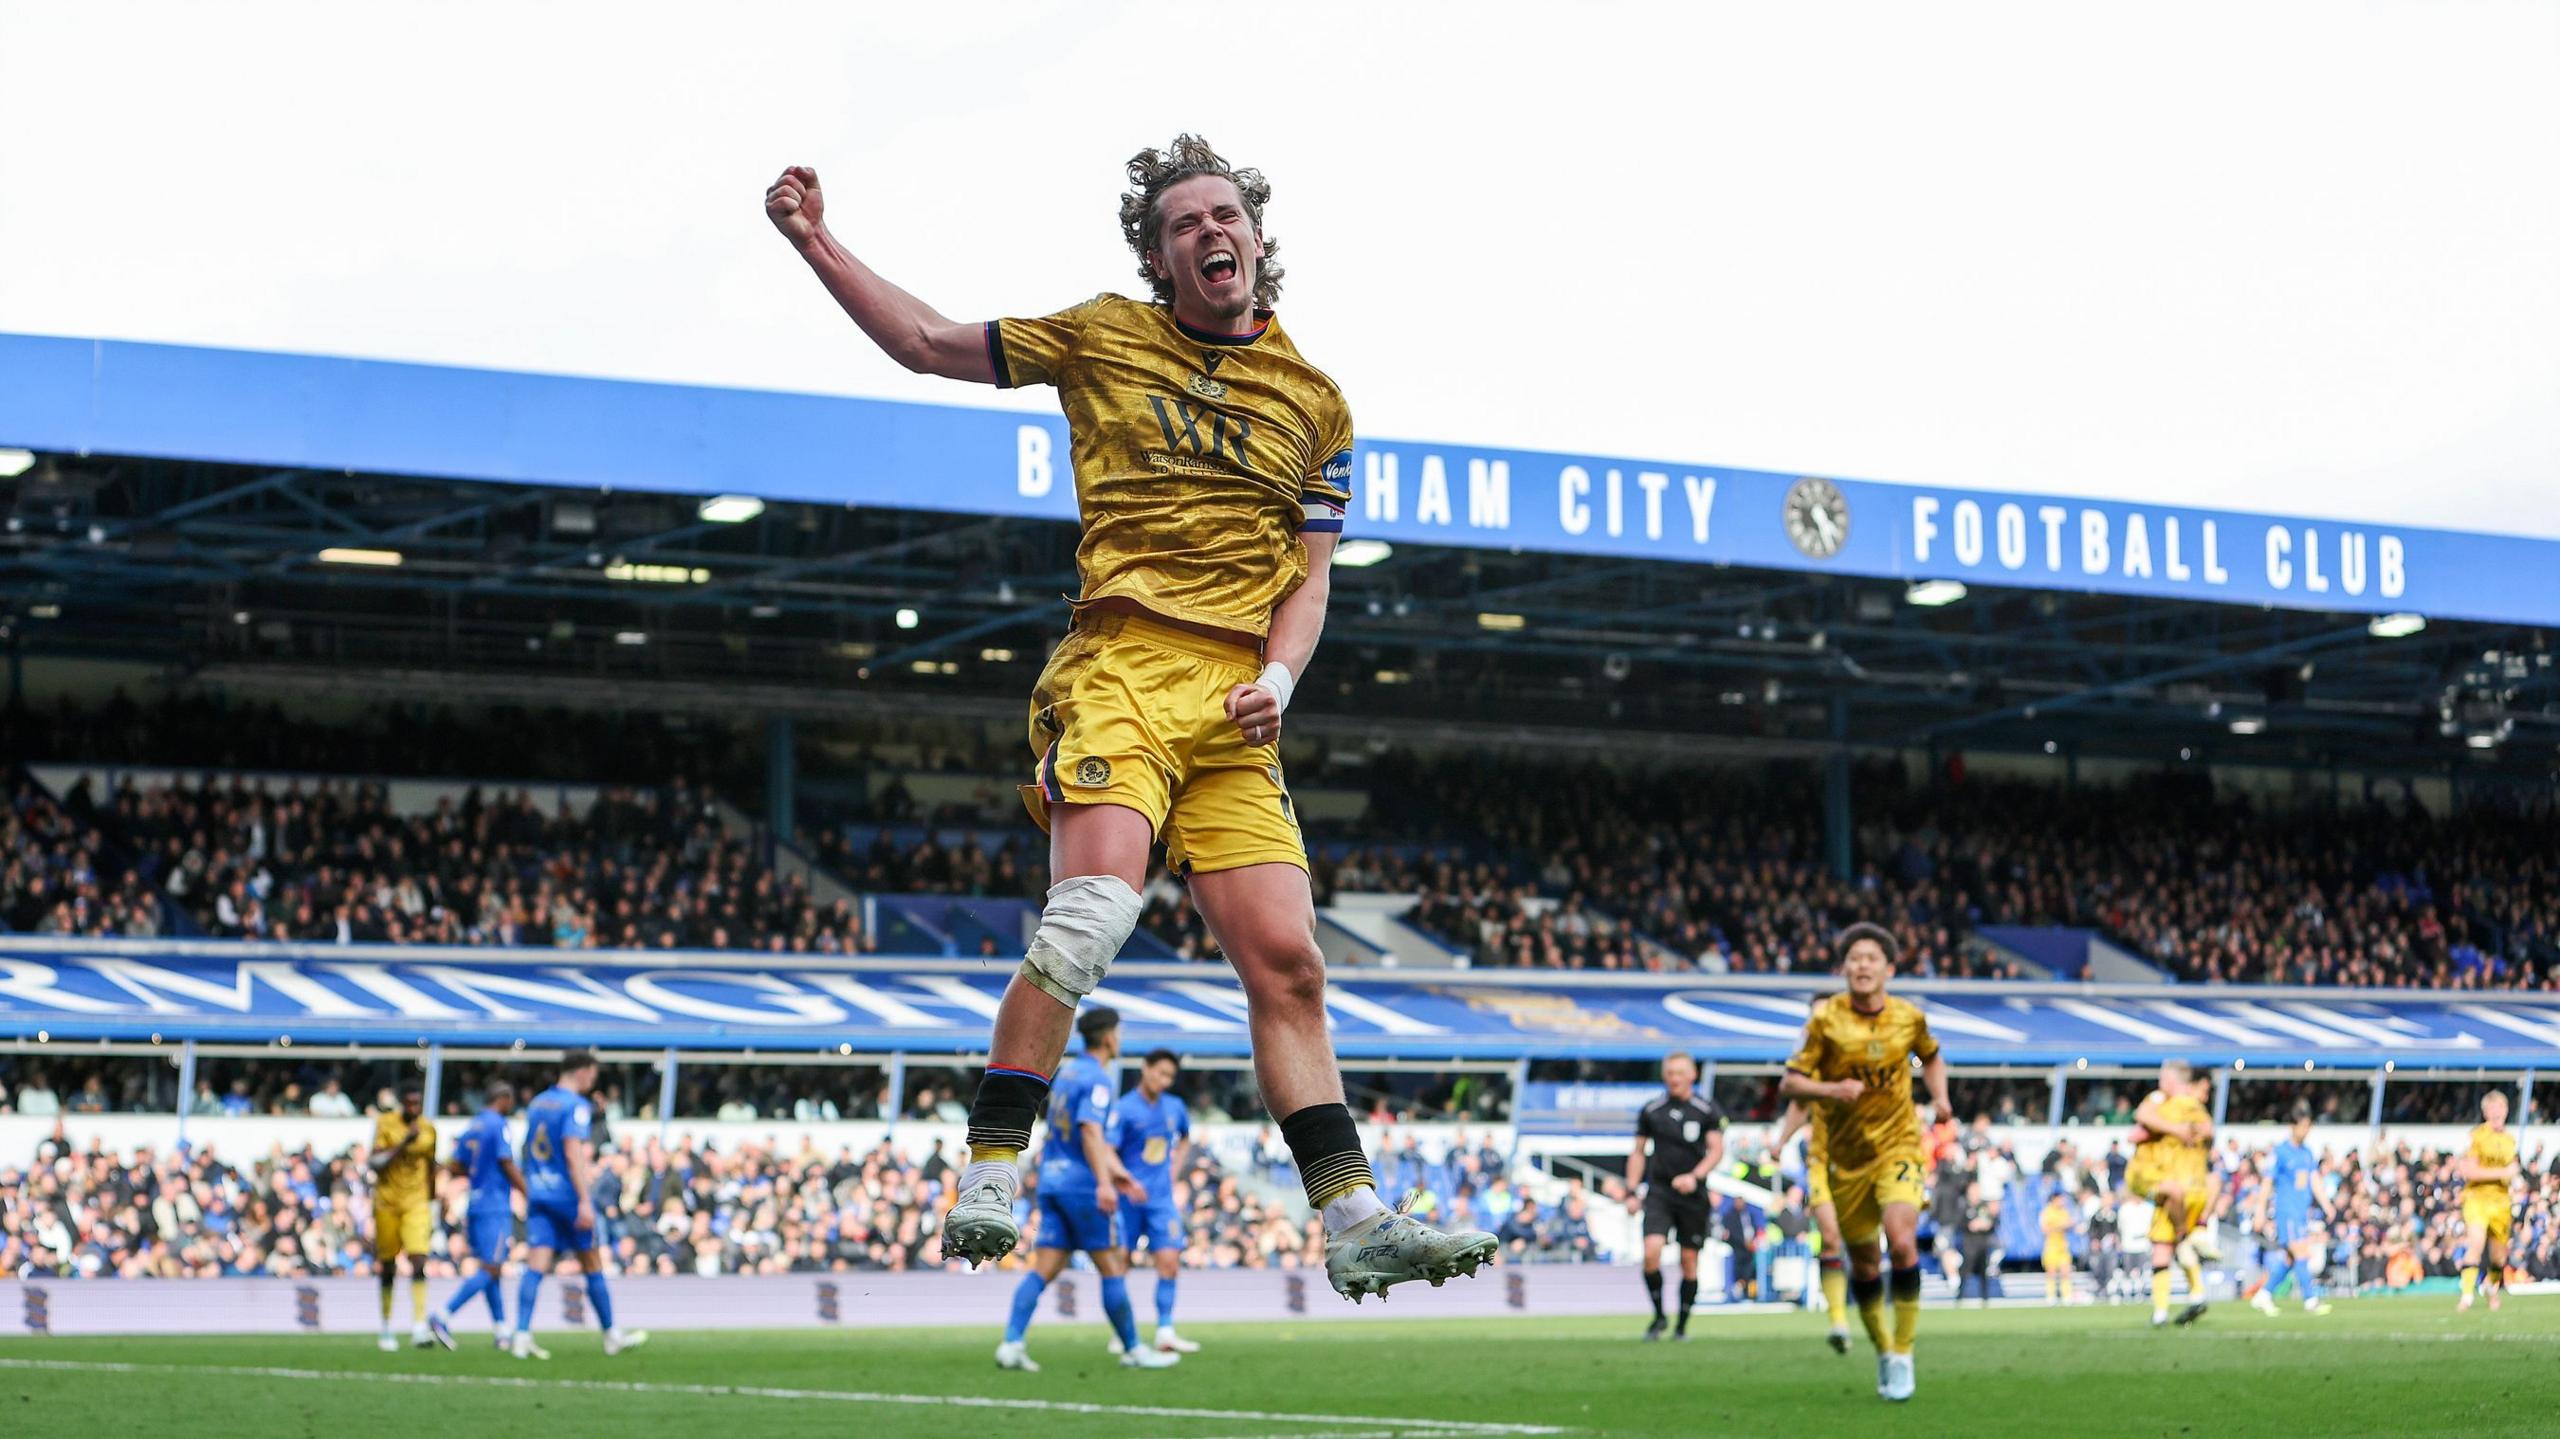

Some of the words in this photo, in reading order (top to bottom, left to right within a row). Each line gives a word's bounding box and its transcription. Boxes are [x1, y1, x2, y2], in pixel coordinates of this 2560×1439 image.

[1145, 393, 1251, 467] WR
[1558, 464, 1716, 544] CITY
[1912, 496, 2228, 585] FOOTBALL
[2265, 525, 2406, 598] CLUB
[530, 1122, 553, 1162] 6
